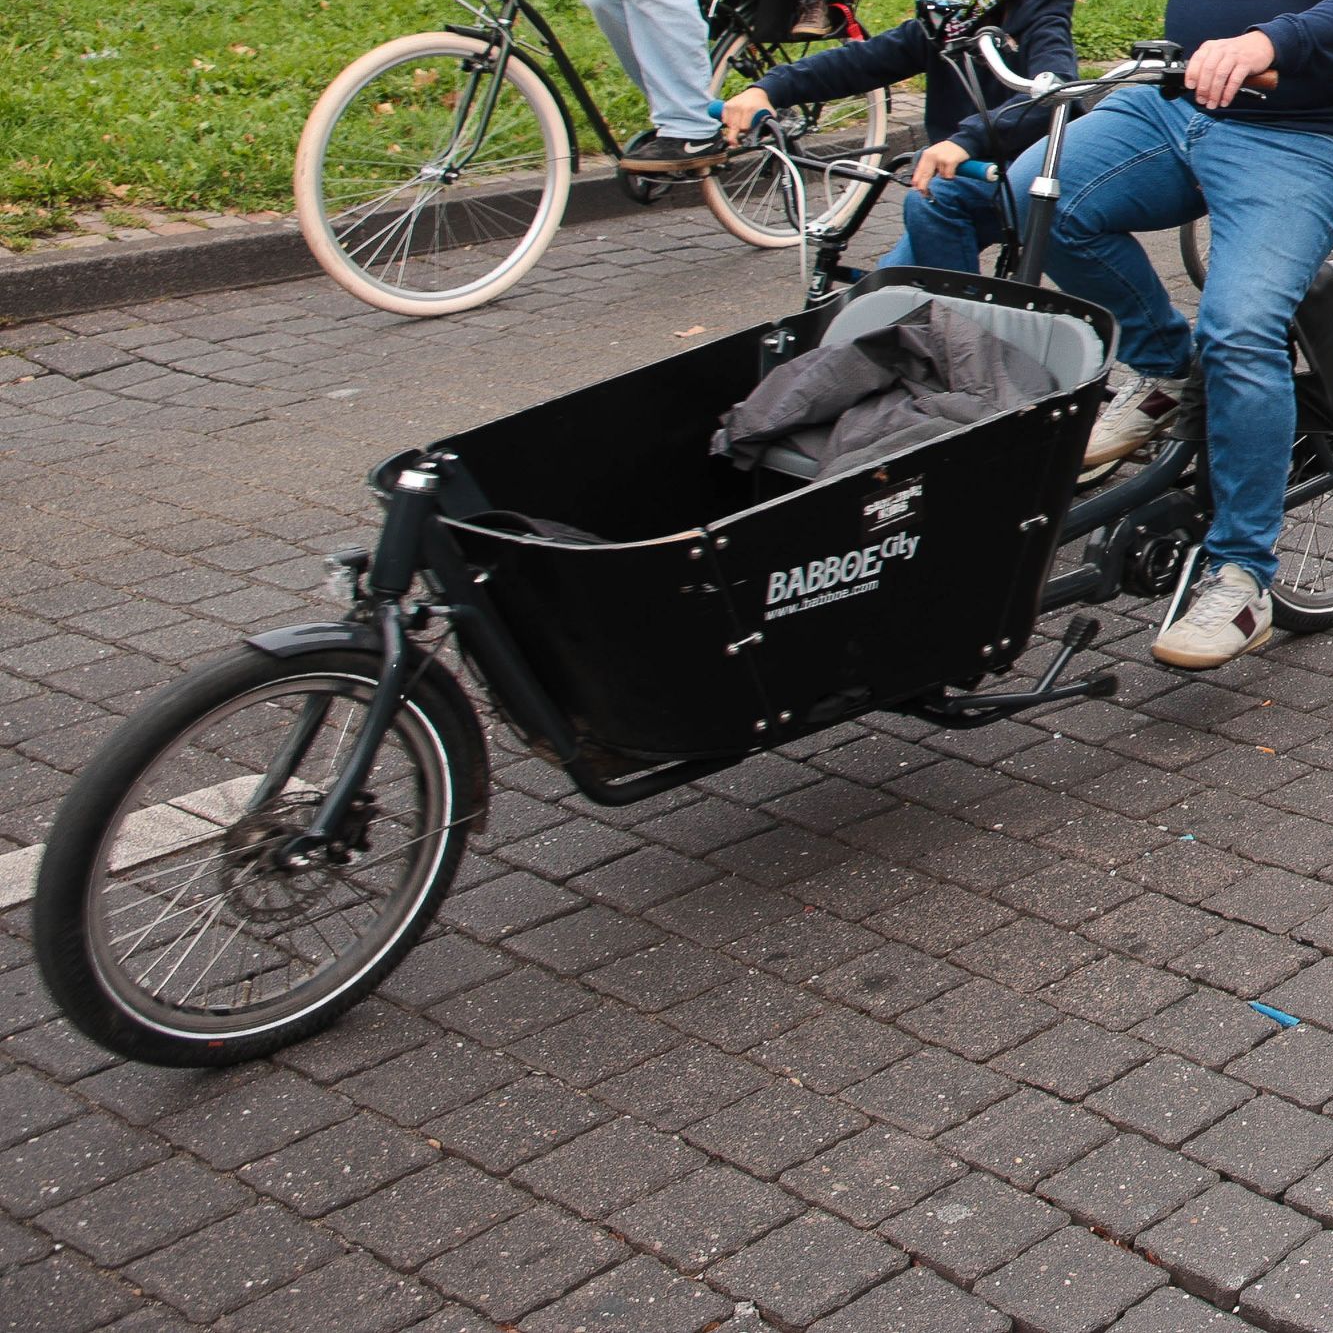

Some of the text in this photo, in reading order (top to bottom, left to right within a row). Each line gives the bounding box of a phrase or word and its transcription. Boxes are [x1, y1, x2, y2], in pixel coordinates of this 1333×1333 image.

[766, 531, 921, 605] BABBOE City
[765, 580, 879, 621] www.babboe.com
